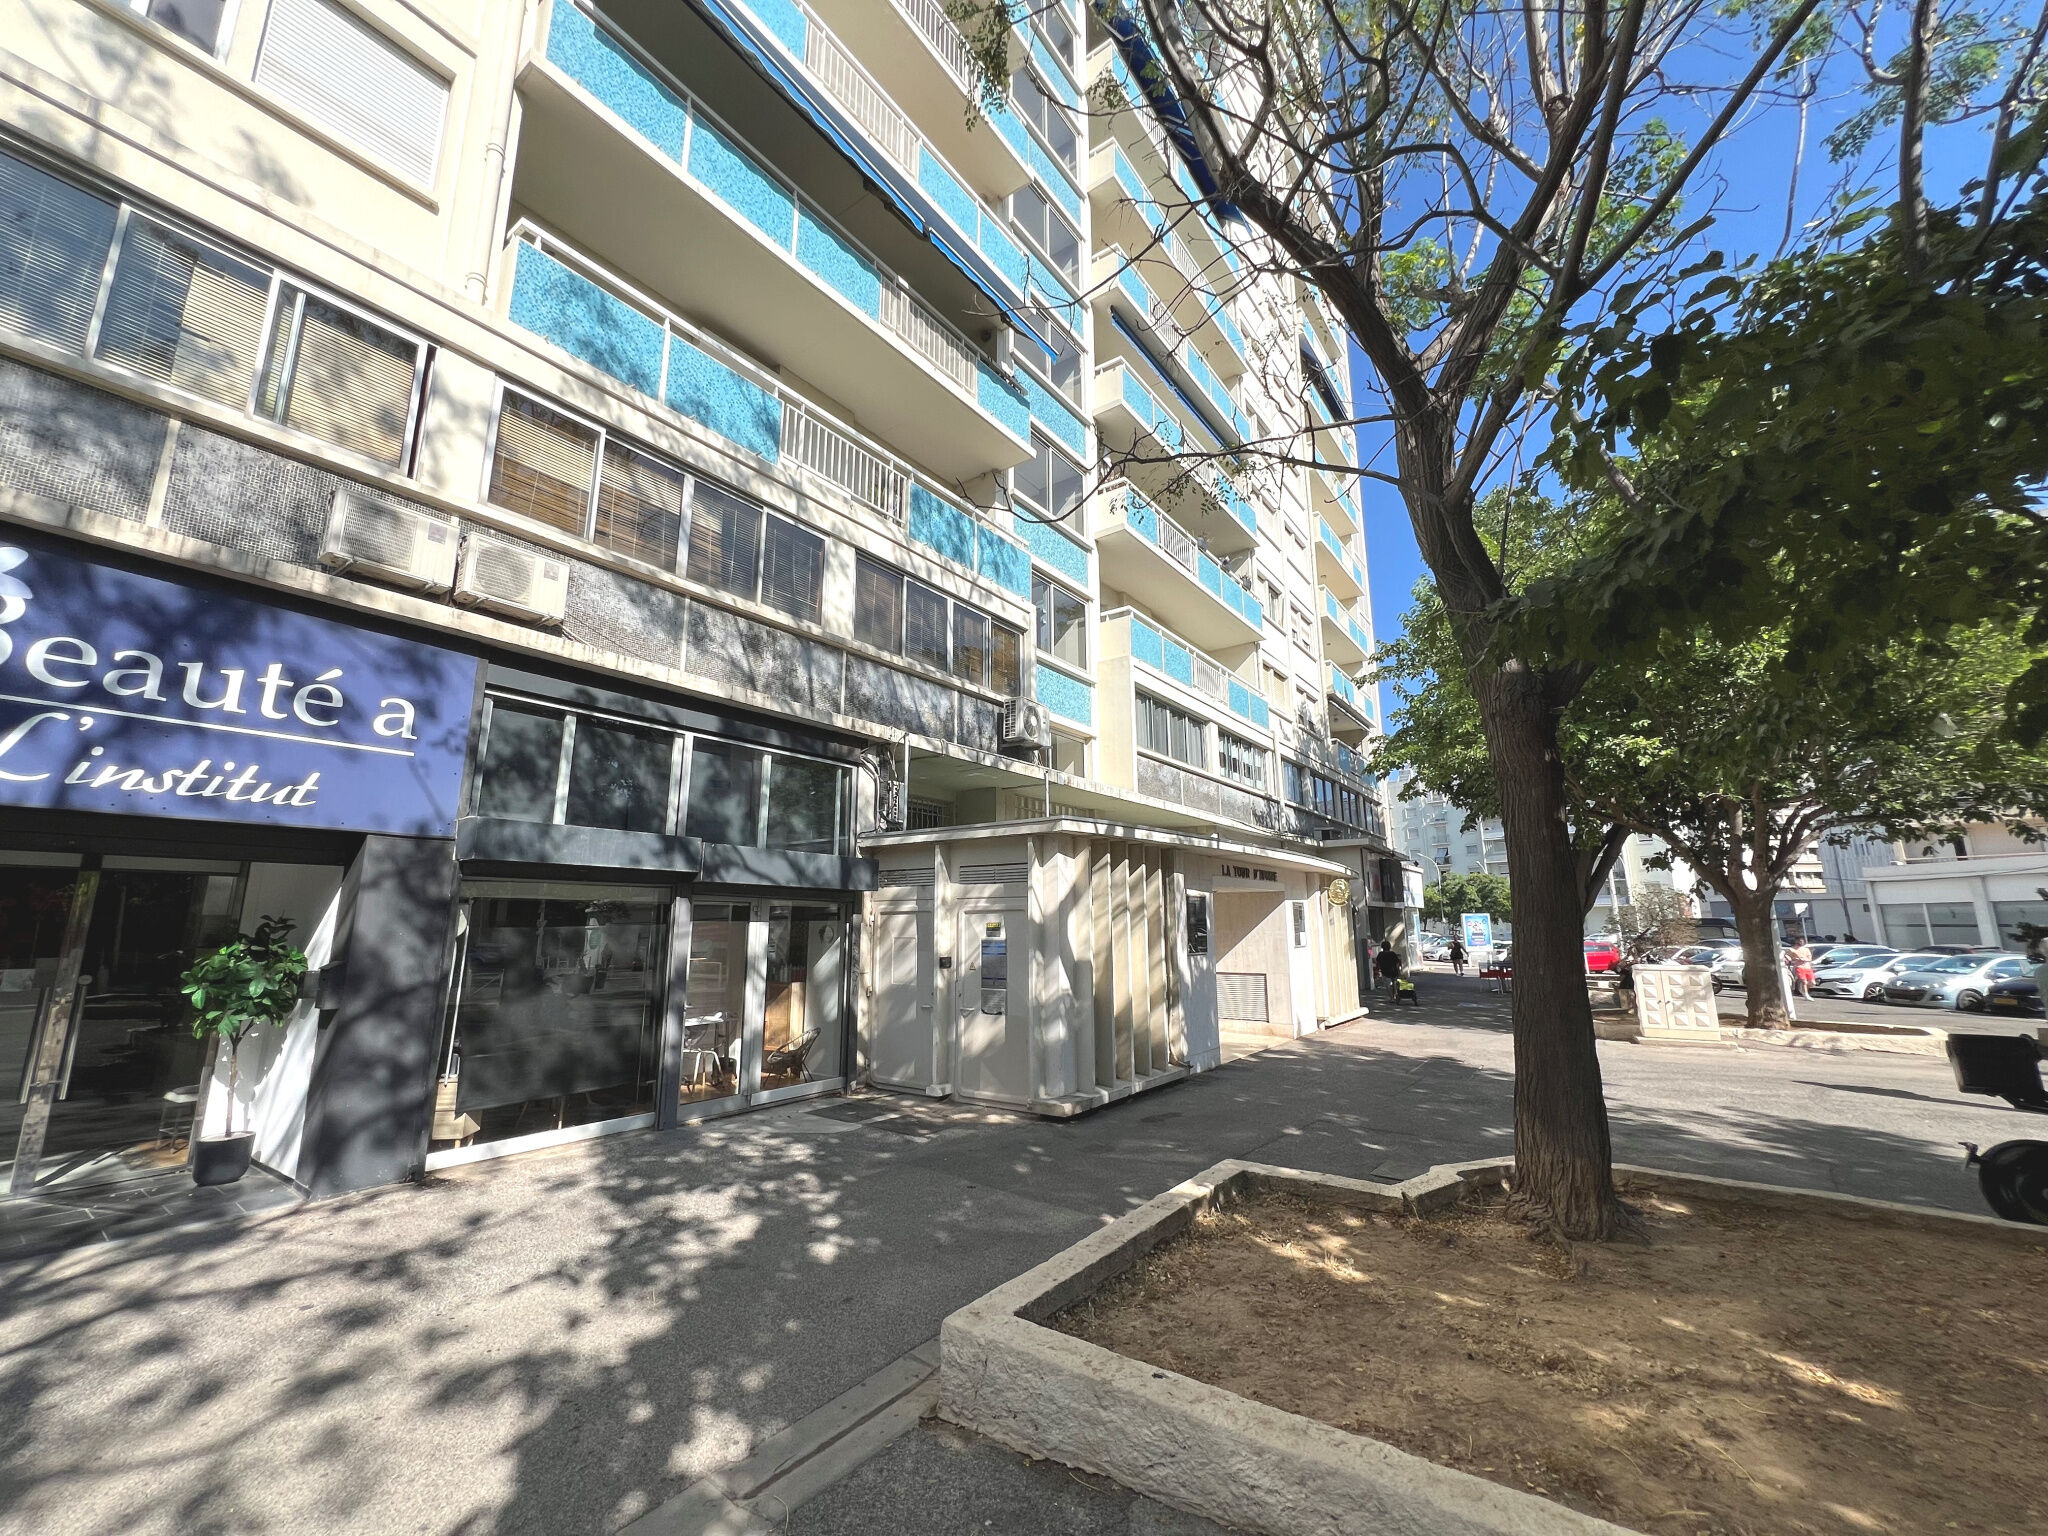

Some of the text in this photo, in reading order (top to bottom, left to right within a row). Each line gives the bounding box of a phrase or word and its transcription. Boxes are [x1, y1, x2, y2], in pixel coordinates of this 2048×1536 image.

[371, 696, 418, 740] a
[1222, 864, 1231, 877] LA
[1233, 865, 1250, 879] TOUR
